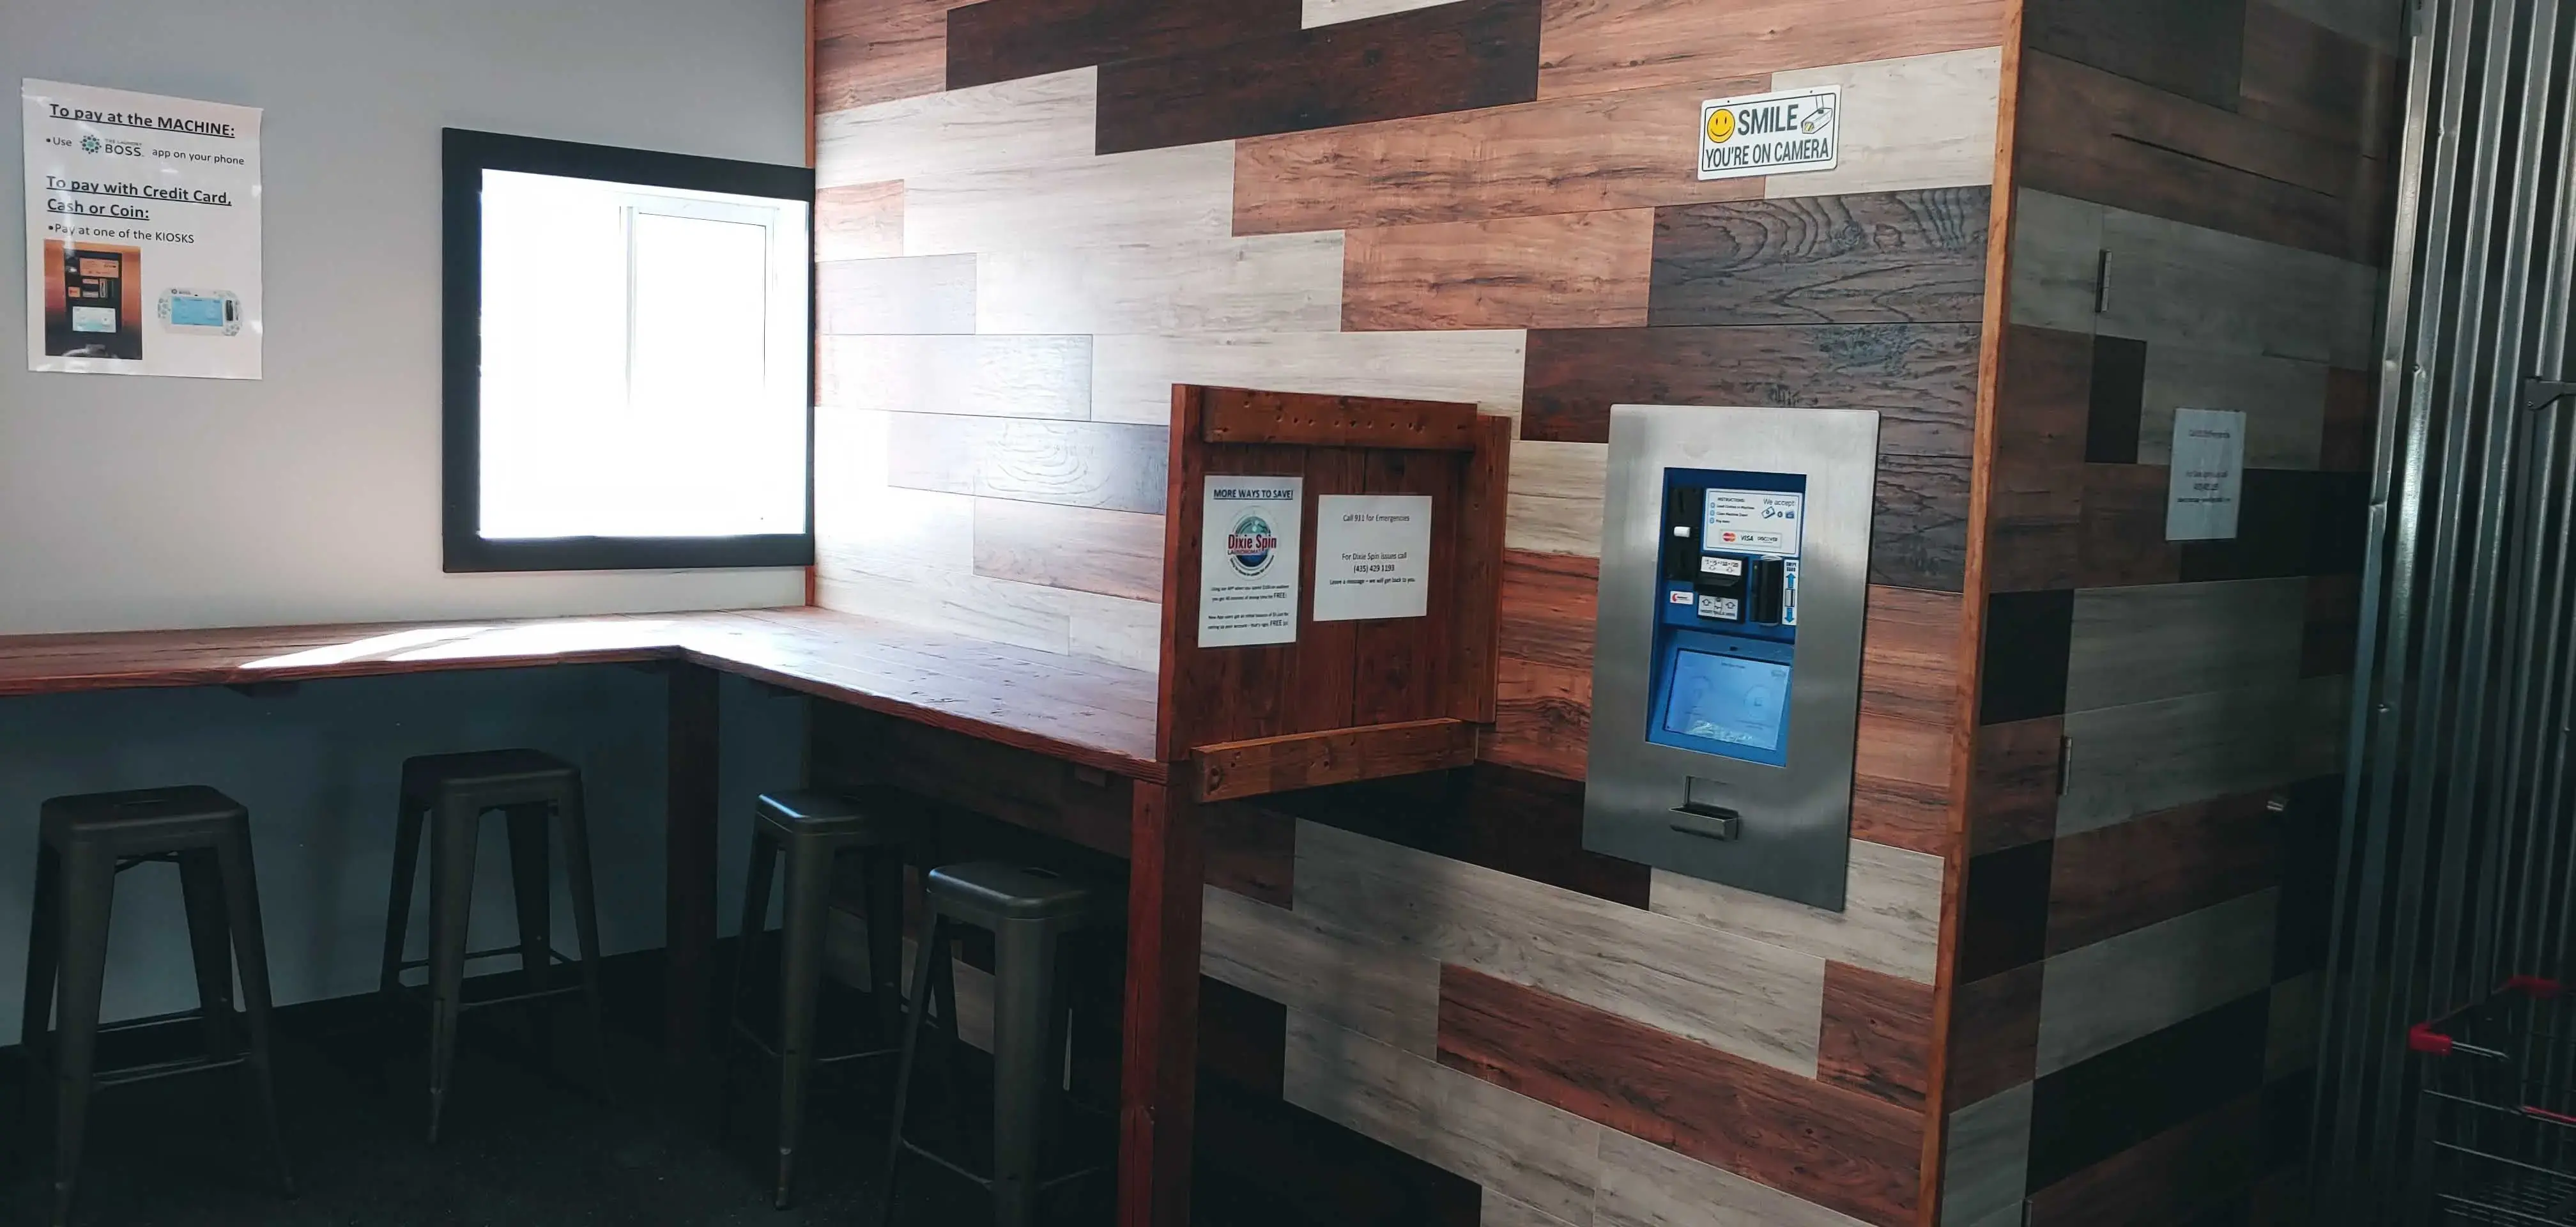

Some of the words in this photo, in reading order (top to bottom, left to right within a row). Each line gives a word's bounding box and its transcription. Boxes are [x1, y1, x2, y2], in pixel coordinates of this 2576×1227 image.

[49, 104, 69, 116] To
[75, 109, 102, 122] pay
[108, 112, 123, 123] at
[128, 113, 152, 127] the
[158, 116, 235, 136] MACHINE:
[1737, 104, 1799, 136] SMILE
[53, 137, 72, 147] Use
[105, 144, 142, 157] BOSS
[152, 149, 171, 159] app
[189, 153, 211, 162] your
[214, 155, 245, 165] phone
[1706, 145, 1750, 168] YOU'RE
[1752, 143, 1771, 164] ON
[1774, 137, 1829, 162] CAMERA
[46, 176, 66, 188] To
[72, 181, 99, 194] pay
[103, 182, 138, 195] with
[143, 185, 189, 200] Credit
[194, 190, 231, 206] Card,
[47, 198, 84, 213] Cash
[89, 204, 105, 215] or
[111, 204, 149, 219] Coin:
[55, 224, 75, 236] Pay
[79, 227, 90, 235] at
[93, 229, 115, 237] one
[118, 229, 130, 238] of
[134, 230, 152, 240] the
[156, 231, 195, 243] KIOSKS
[1214, 489, 1236, 498] MORE
[1238, 489, 1260, 498] WAYS
[1262, 490, 1271, 498] TO
[1273, 490, 1294, 499] SAVE!
[1376, 514, 1409, 523] Emergencies
[1228, 534, 1252, 549] Dixie
[1255, 534, 1277, 552] Spin
[1367, 552, 1379, 560] Spin
[1353, 564, 1368, 574] (435)
